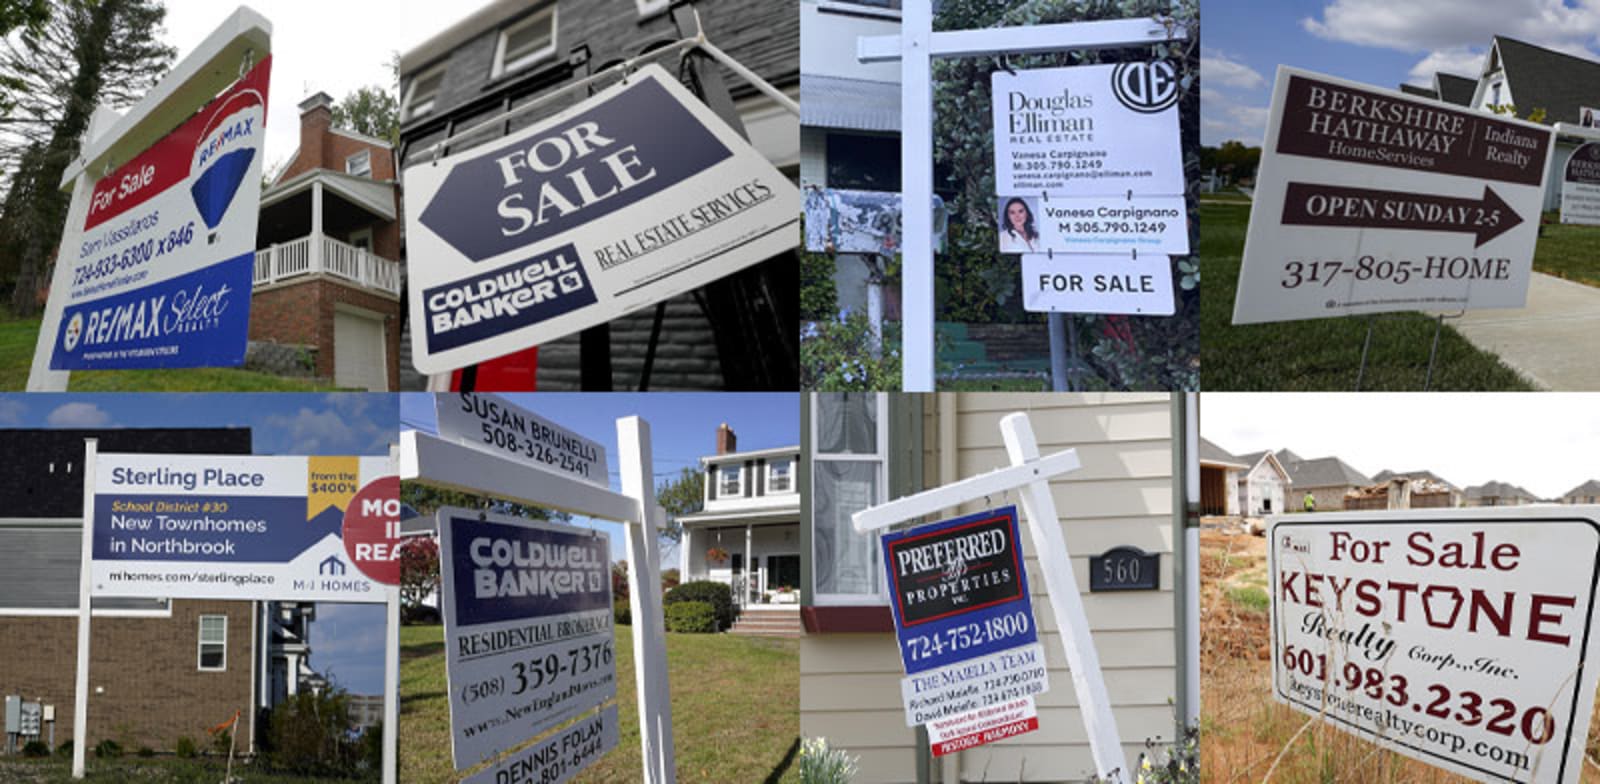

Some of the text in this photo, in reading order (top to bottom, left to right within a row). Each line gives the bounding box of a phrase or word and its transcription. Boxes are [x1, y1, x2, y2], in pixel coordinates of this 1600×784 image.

[1008, 88, 1093, 116] Douglas
[1306, 85, 1465, 136] BERKSHIRE
[1009, 113, 1094, 135] Elliman
[1010, 133, 1094, 145] REAL ESTATE
[1307, 111, 1456, 155] HATHAWAY
[1484, 125, 1538, 150] Indiana
[495, 120, 616, 189] FOR
[1011, 149, 1108, 162] Vanesa Carpignano
[1327, 139, 1435, 168] HomeServices
[1485, 145, 1532, 170] Realty
[91, 164, 155, 215] For Sale
[496, 144, 657, 236] SALE
[1012, 180, 1064, 189] elliman.com
[594, 238, 639, 269] REAL
[634, 213, 696, 251] ESTATE
[690, 178, 773, 226] SERVICES
[1045, 205, 1179, 221] Vanesa Carpignano
[1058, 221, 1167, 233] M 305.790.1249
[1305, 194, 1501, 228] OPEN SUNDAY 2-5
[156, 221, 195, 257] x846
[428, 254, 577, 312] COLDWELL
[1039, 273, 1155, 293] FOR SALE
[1281, 255, 1511, 289] 317-805-HOME
[83, 295, 167, 345] RE/MAX
[164, 284, 232, 335] Select
[431, 280, 559, 335] BANKER
[460, 392, 597, 463] SUSAN BRUNELLI
[481, 423, 590, 477] 508-326-2541
[111, 467, 265, 490] Sterling Place
[311, 472, 356, 481] from the
[311, 482, 357, 494] $400's
[111, 499, 228, 513] School District #30
[111, 513, 267, 533] New Townhomes
[109, 536, 236, 556] in Northbrook
[469, 536, 602, 569] COLDWELL
[896, 528, 1006, 577] PREFERRED
[1329, 530, 1391, 564] For
[1406, 531, 1521, 571] Sale
[321, 580, 371, 591] HOMES
[474, 566, 585, 600] BANKER
[906, 568, 1011, 606] PROPERTIES
[1103, 558, 1140, 584] 560
[1280, 571, 1577, 648] KEYSTONE
[458, 624, 552, 657] RESIDENTIAL
[906, 610, 1029, 663] 724-752-1800
[1300, 611, 1398, 662] Realty
[461, 639, 613, 705] (508) 359-7376
[912, 674, 939, 693] THE
[1001, 650, 1036, 671] TEAM
[1282, 644, 1556, 746] 601.983.2320
[496, 717, 603, 784] DENNIS FOLAN
